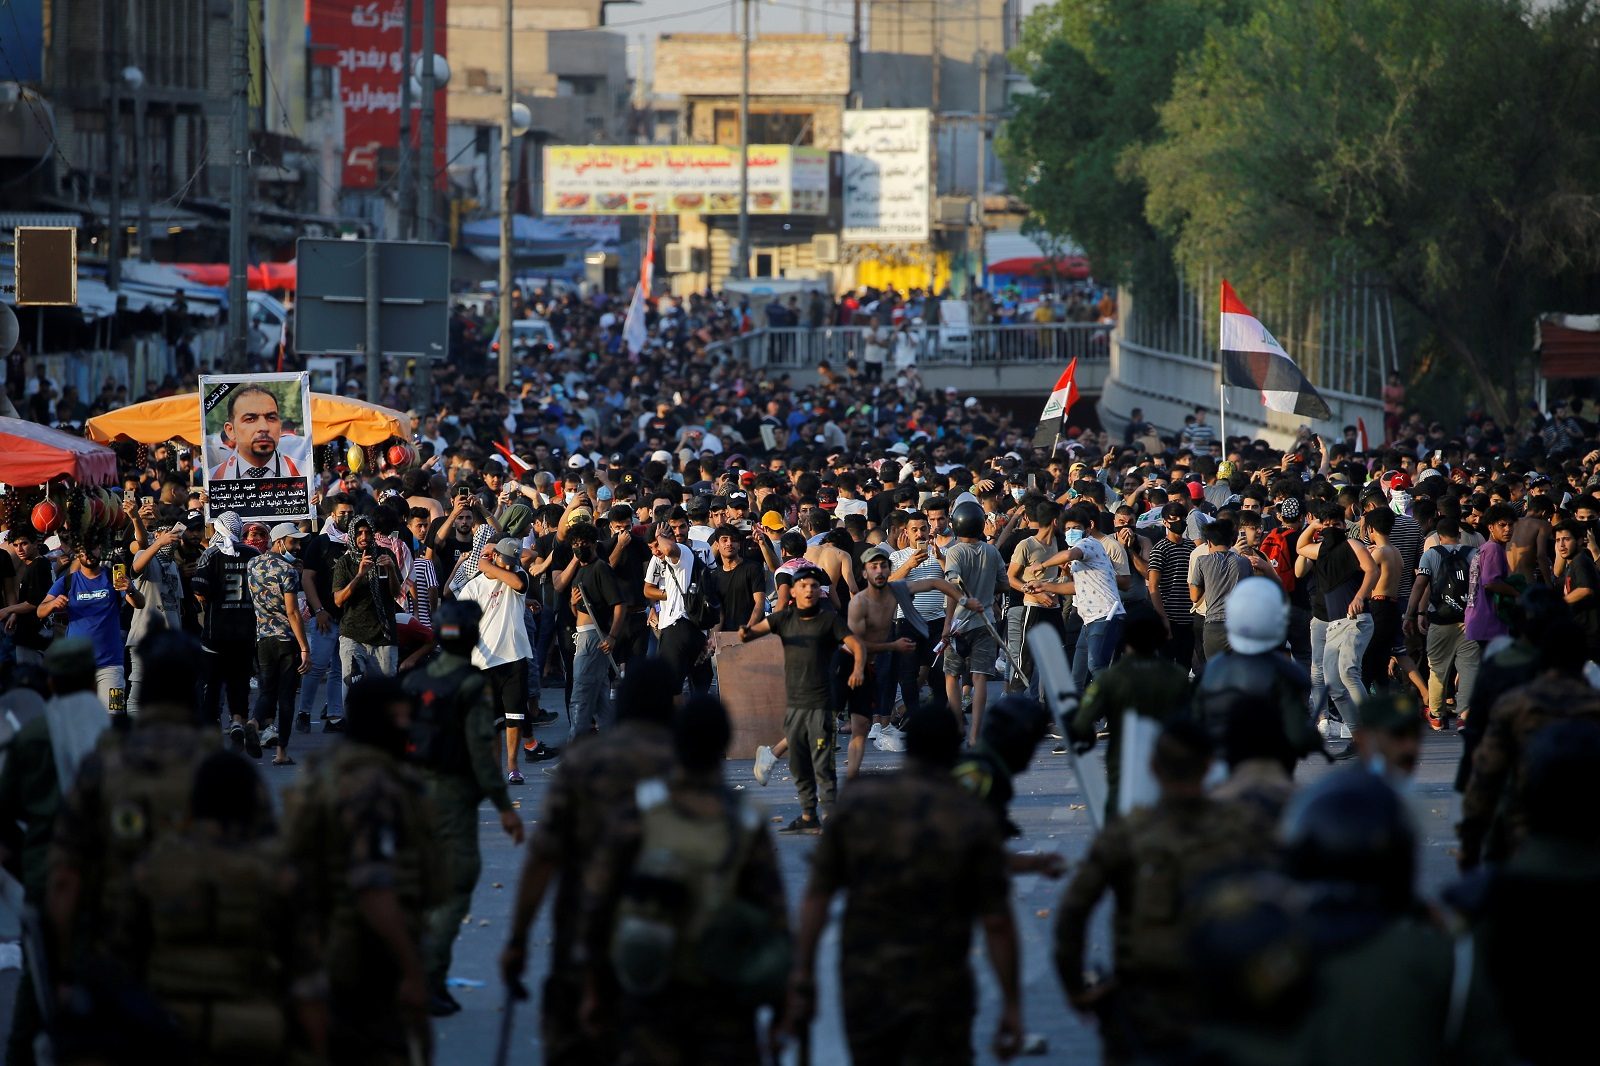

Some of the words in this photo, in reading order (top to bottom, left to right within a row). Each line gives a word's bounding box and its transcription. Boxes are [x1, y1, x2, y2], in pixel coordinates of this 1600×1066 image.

[211, 484, 226, 492] تشرين
[230, 483, 240, 492] ثورة
[243, 483, 256, 491] شهيد
[247, 492, 256, 500] على
[275, 490, 285, 499] الذي
